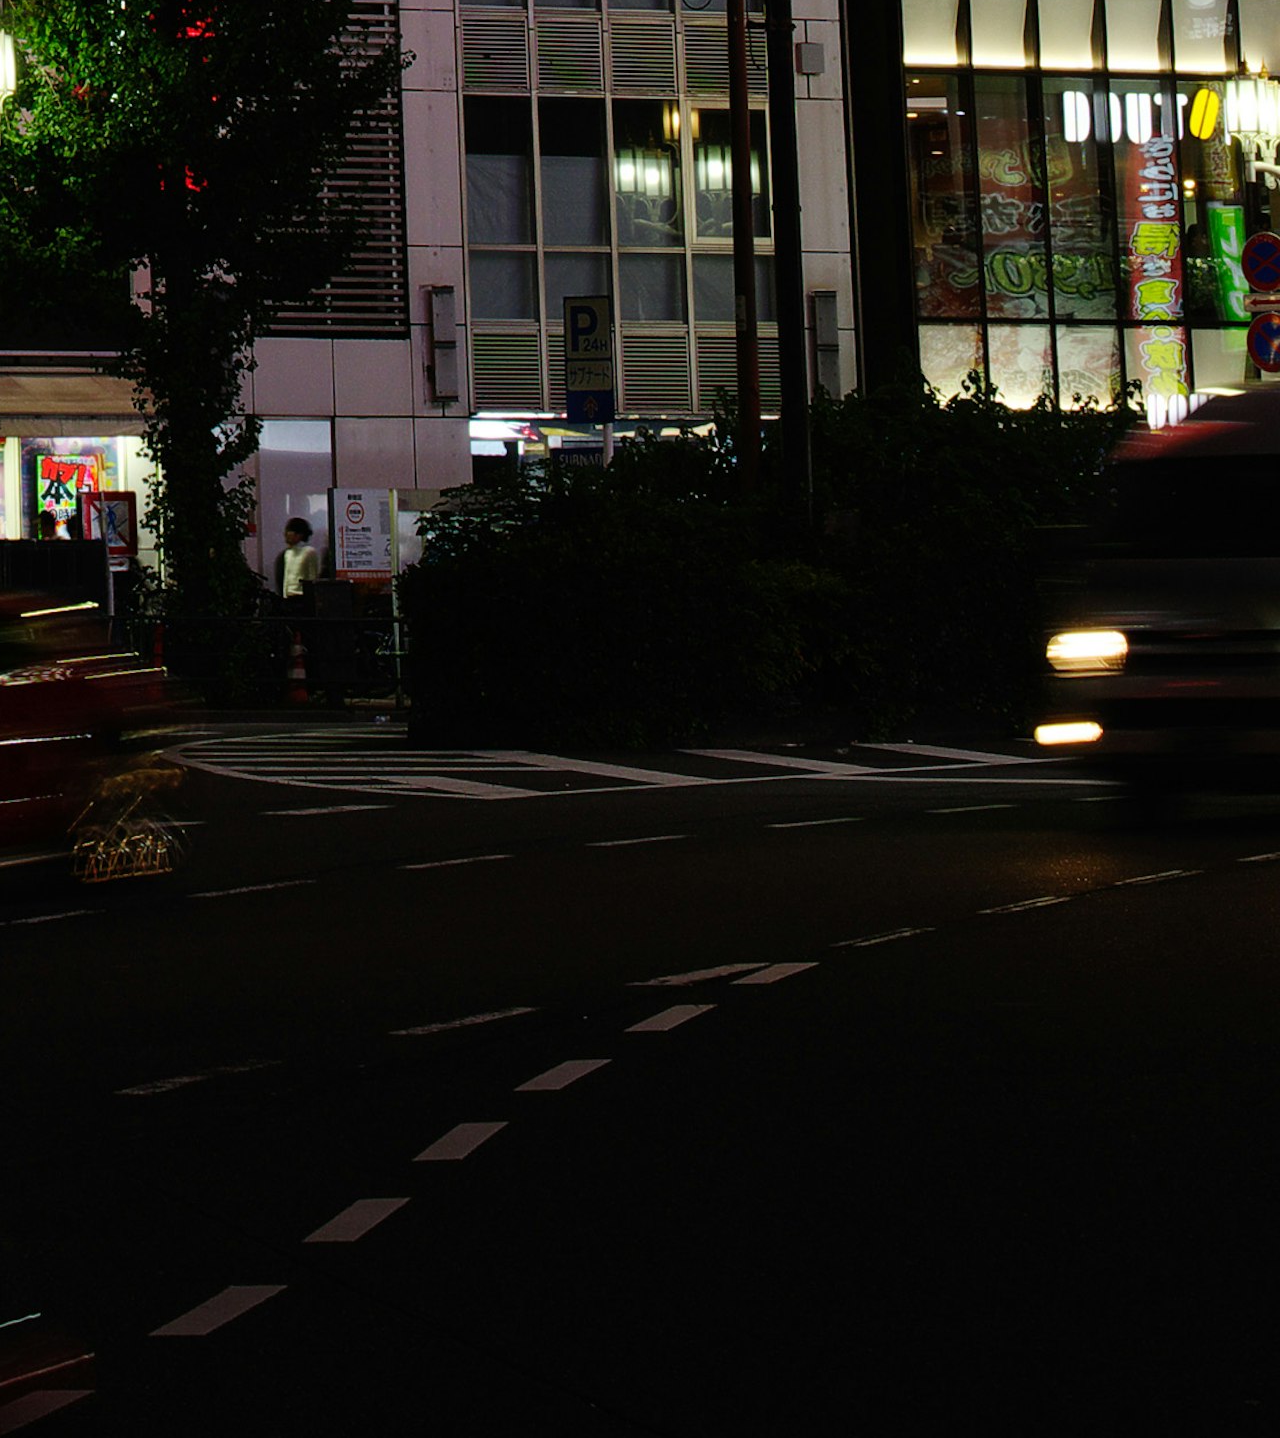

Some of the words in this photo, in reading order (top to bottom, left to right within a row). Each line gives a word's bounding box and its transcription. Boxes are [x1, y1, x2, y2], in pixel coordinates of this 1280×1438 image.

[1062, 88, 1232, 146] DOUTO
[570, 305, 598, 352] P
[583, 338, 609, 352] 24H
